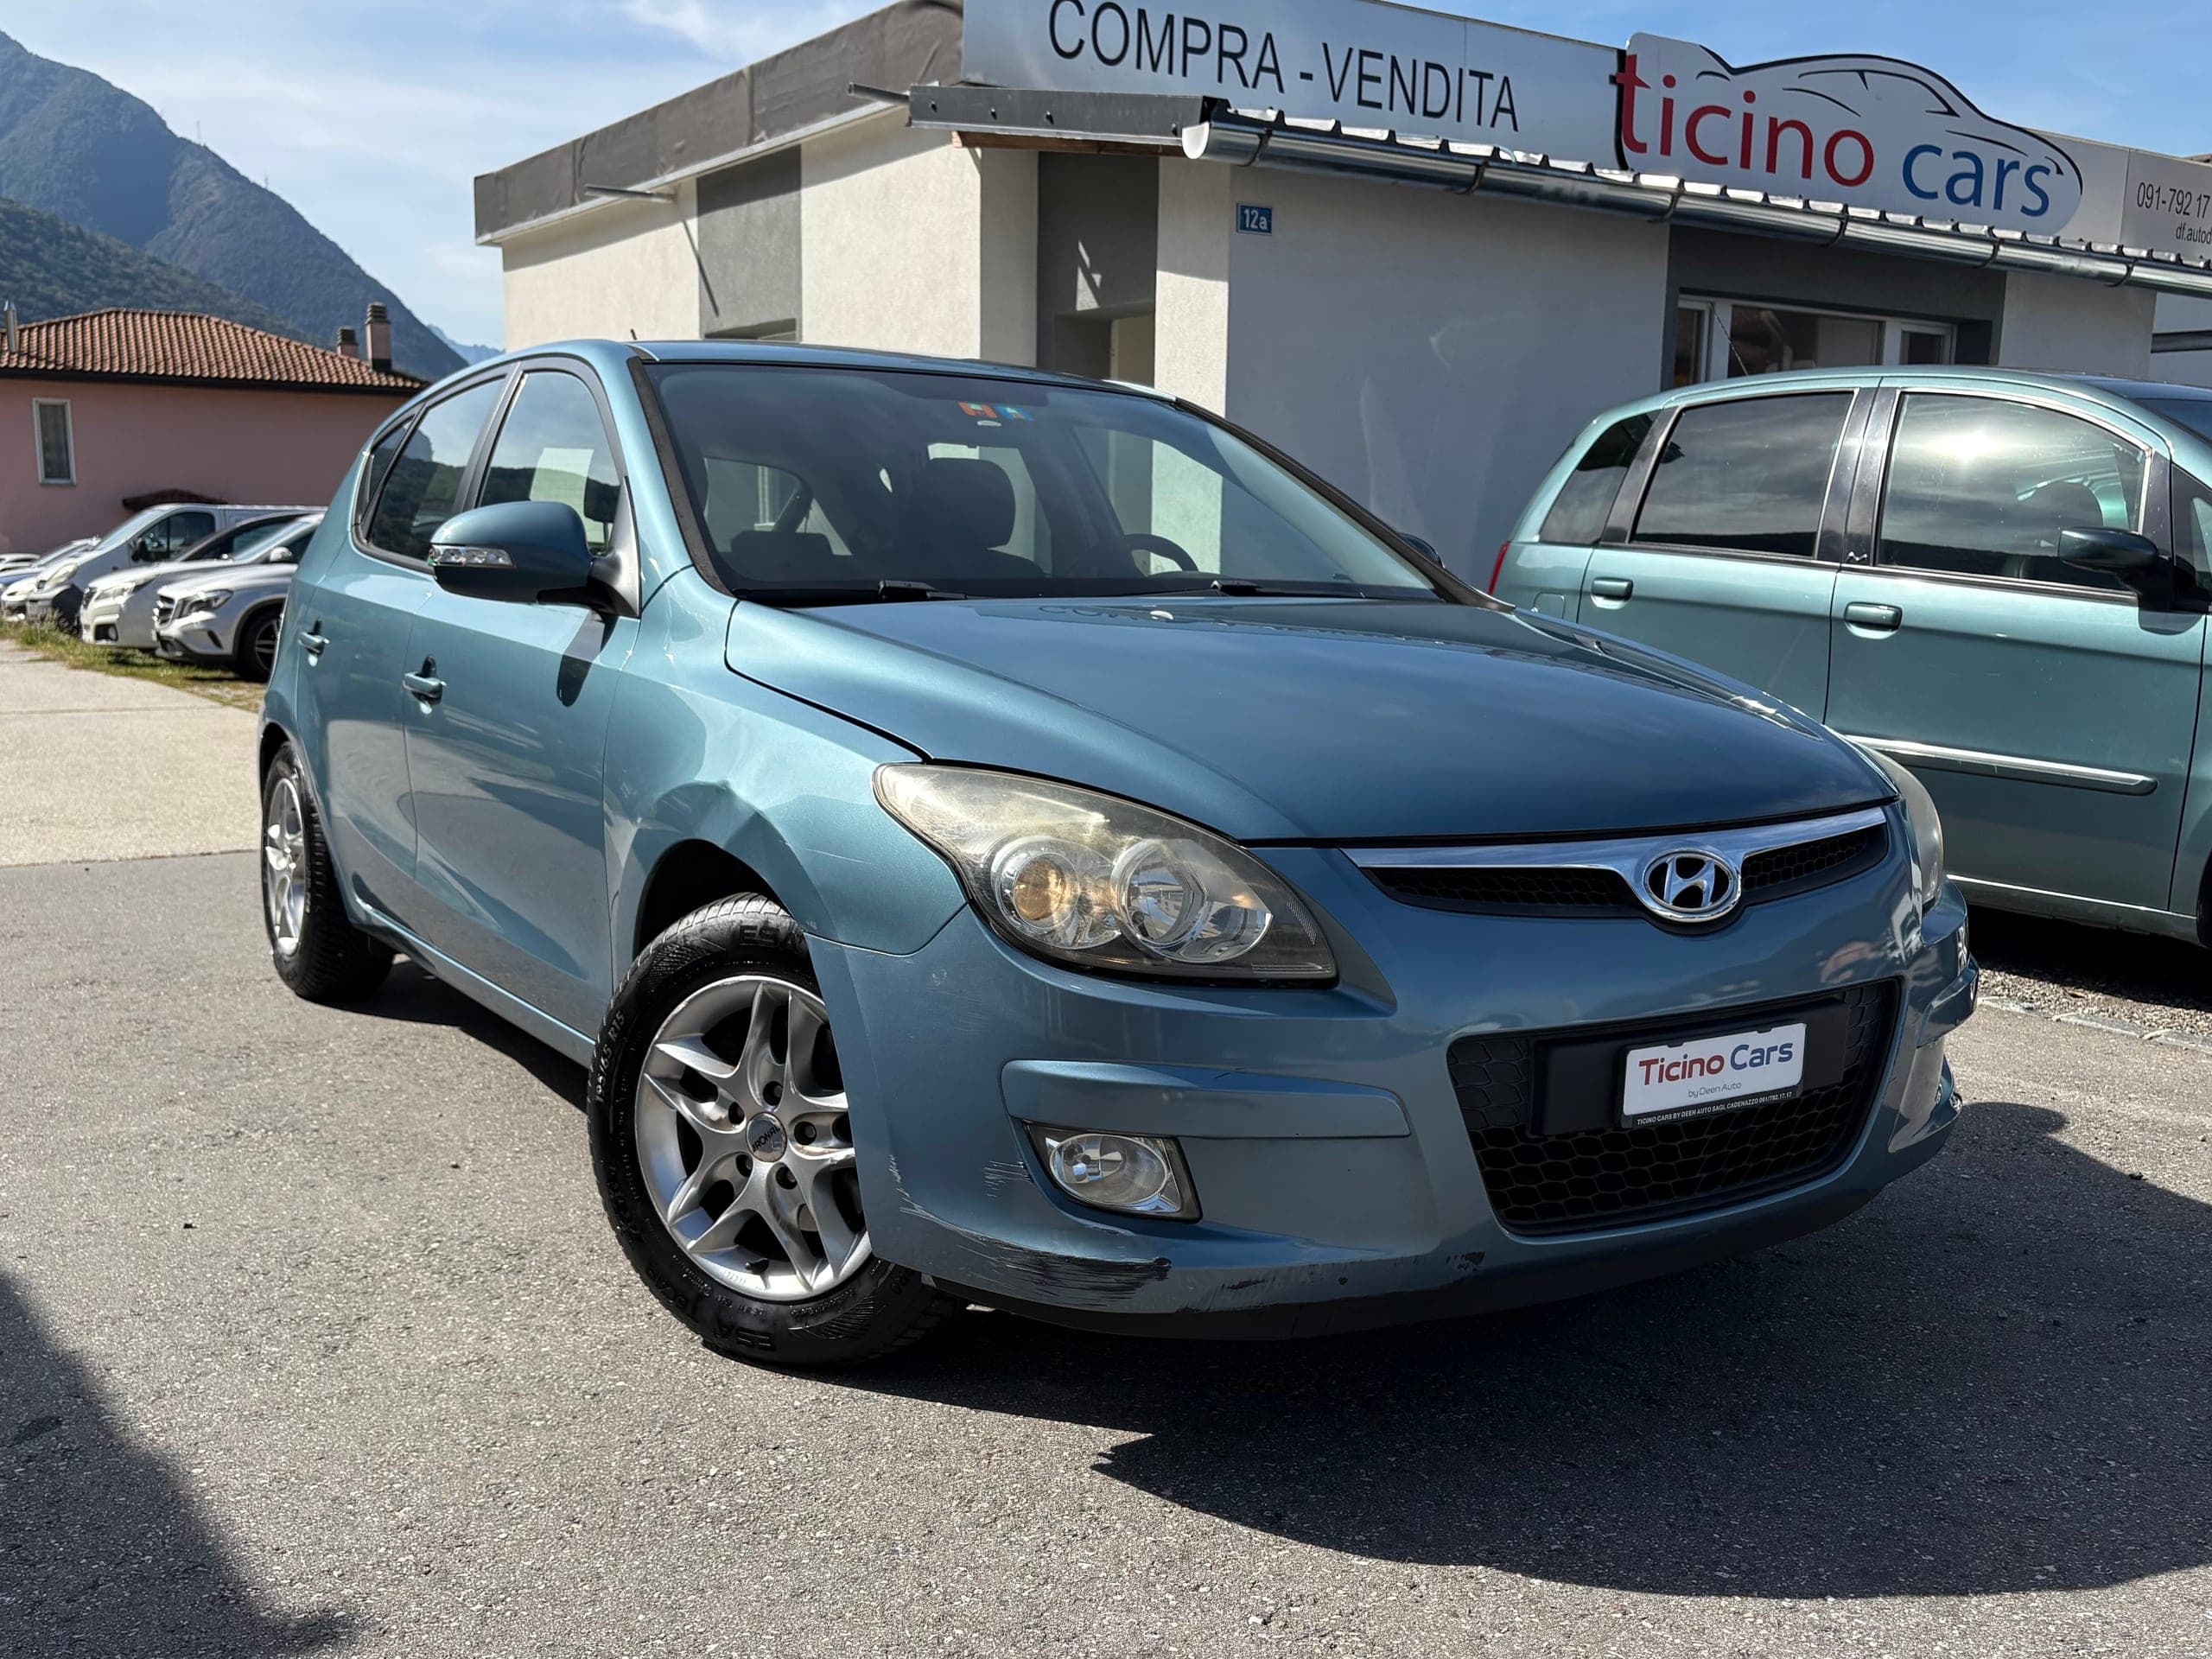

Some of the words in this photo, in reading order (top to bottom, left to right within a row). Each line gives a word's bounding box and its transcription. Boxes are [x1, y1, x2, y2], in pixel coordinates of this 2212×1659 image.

[1048, 0, 1285, 94] COMPRA
[1321, 42, 1519, 132] VENDITA
[1615, 54, 1875, 188] ticino
[1902, 143, 2051, 218] cars
[2136, 181, 2192, 217] 091-792
[2196, 193, 2211, 219] 17
[1243, 208, 1268, 231] 12a
[1638, 1053, 1725, 1086] Ticino
[1730, 1042, 1793, 1071] Cars
[1688, 1089, 1699, 1098] by
[1699, 1085, 1721, 1096] Deen
[1721, 1082, 1742, 1092] Auto
[1637, 1116, 1656, 1126] TICINO
[1656, 1113, 1673, 1122] CARS
[1696, 1105, 1712, 1116] AUTO
[753, 1125, 781, 1153] RONAL
